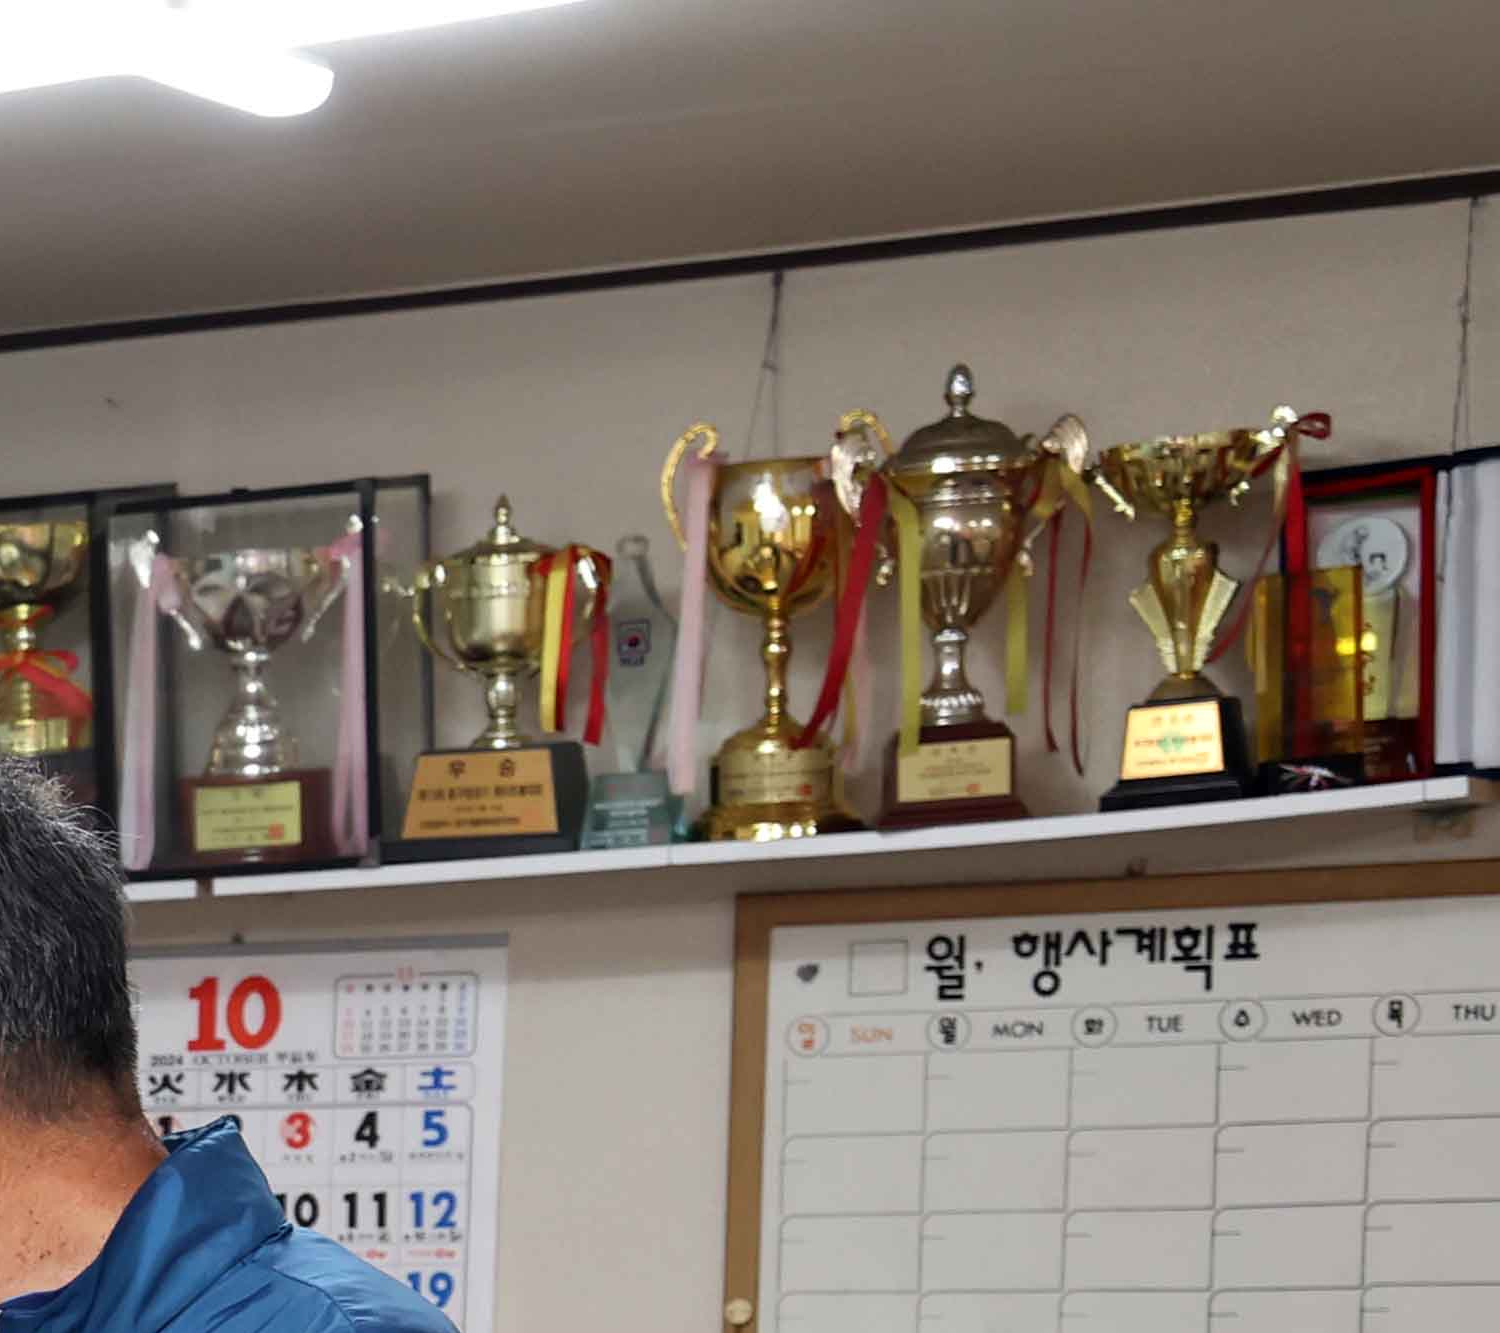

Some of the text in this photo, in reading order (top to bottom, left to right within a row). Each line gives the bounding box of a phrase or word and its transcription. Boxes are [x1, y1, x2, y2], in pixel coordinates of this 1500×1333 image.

[1012, 923, 1260, 998] 행사계획표
[187, 976, 282, 1052] 10
[1148, 1014, 1184, 1033] TUE
[1292, 1009, 1342, 1028] WED
[1451, 1003, 1497, 1022] THU
[852, 1025, 893, 1044] SUN
[992, 1021, 1044, 1039] MON
[151, 1054, 184, 1067] 2024
[148, 1073, 184, 1096] 火
[212, 1069, 252, 1095] 水
[283, 1069, 319, 1092] 木
[350, 1068, 388, 1093] 金
[418, 1067, 456, 1092] 土
[285, 1111, 312, 1149] 3
[354, 1111, 380, 1149] 4
[422, 1109, 449, 1148] 5
[343, 1191, 387, 1229] 11
[409, 1191, 457, 1229] 12
